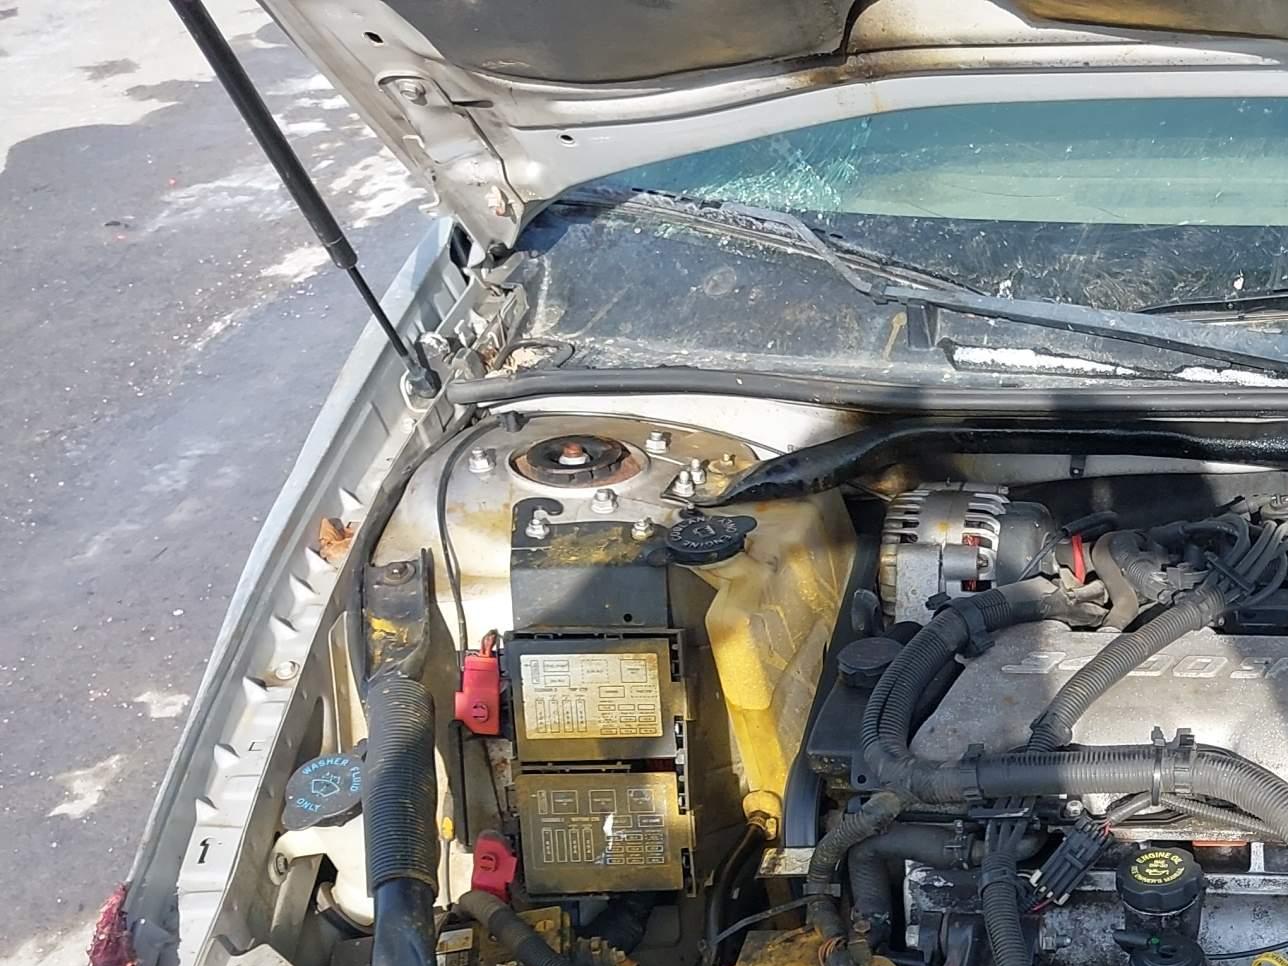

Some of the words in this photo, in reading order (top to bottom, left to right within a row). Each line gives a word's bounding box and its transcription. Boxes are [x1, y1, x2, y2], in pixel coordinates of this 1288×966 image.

[683, 535, 731, 548] ENGINE
[302, 758, 349, 775] WASHER
[350, 766, 361, 791] FLUID
[296, 798, 321, 812] ONLY
[1136, 852, 1171, 863] ENGINE
